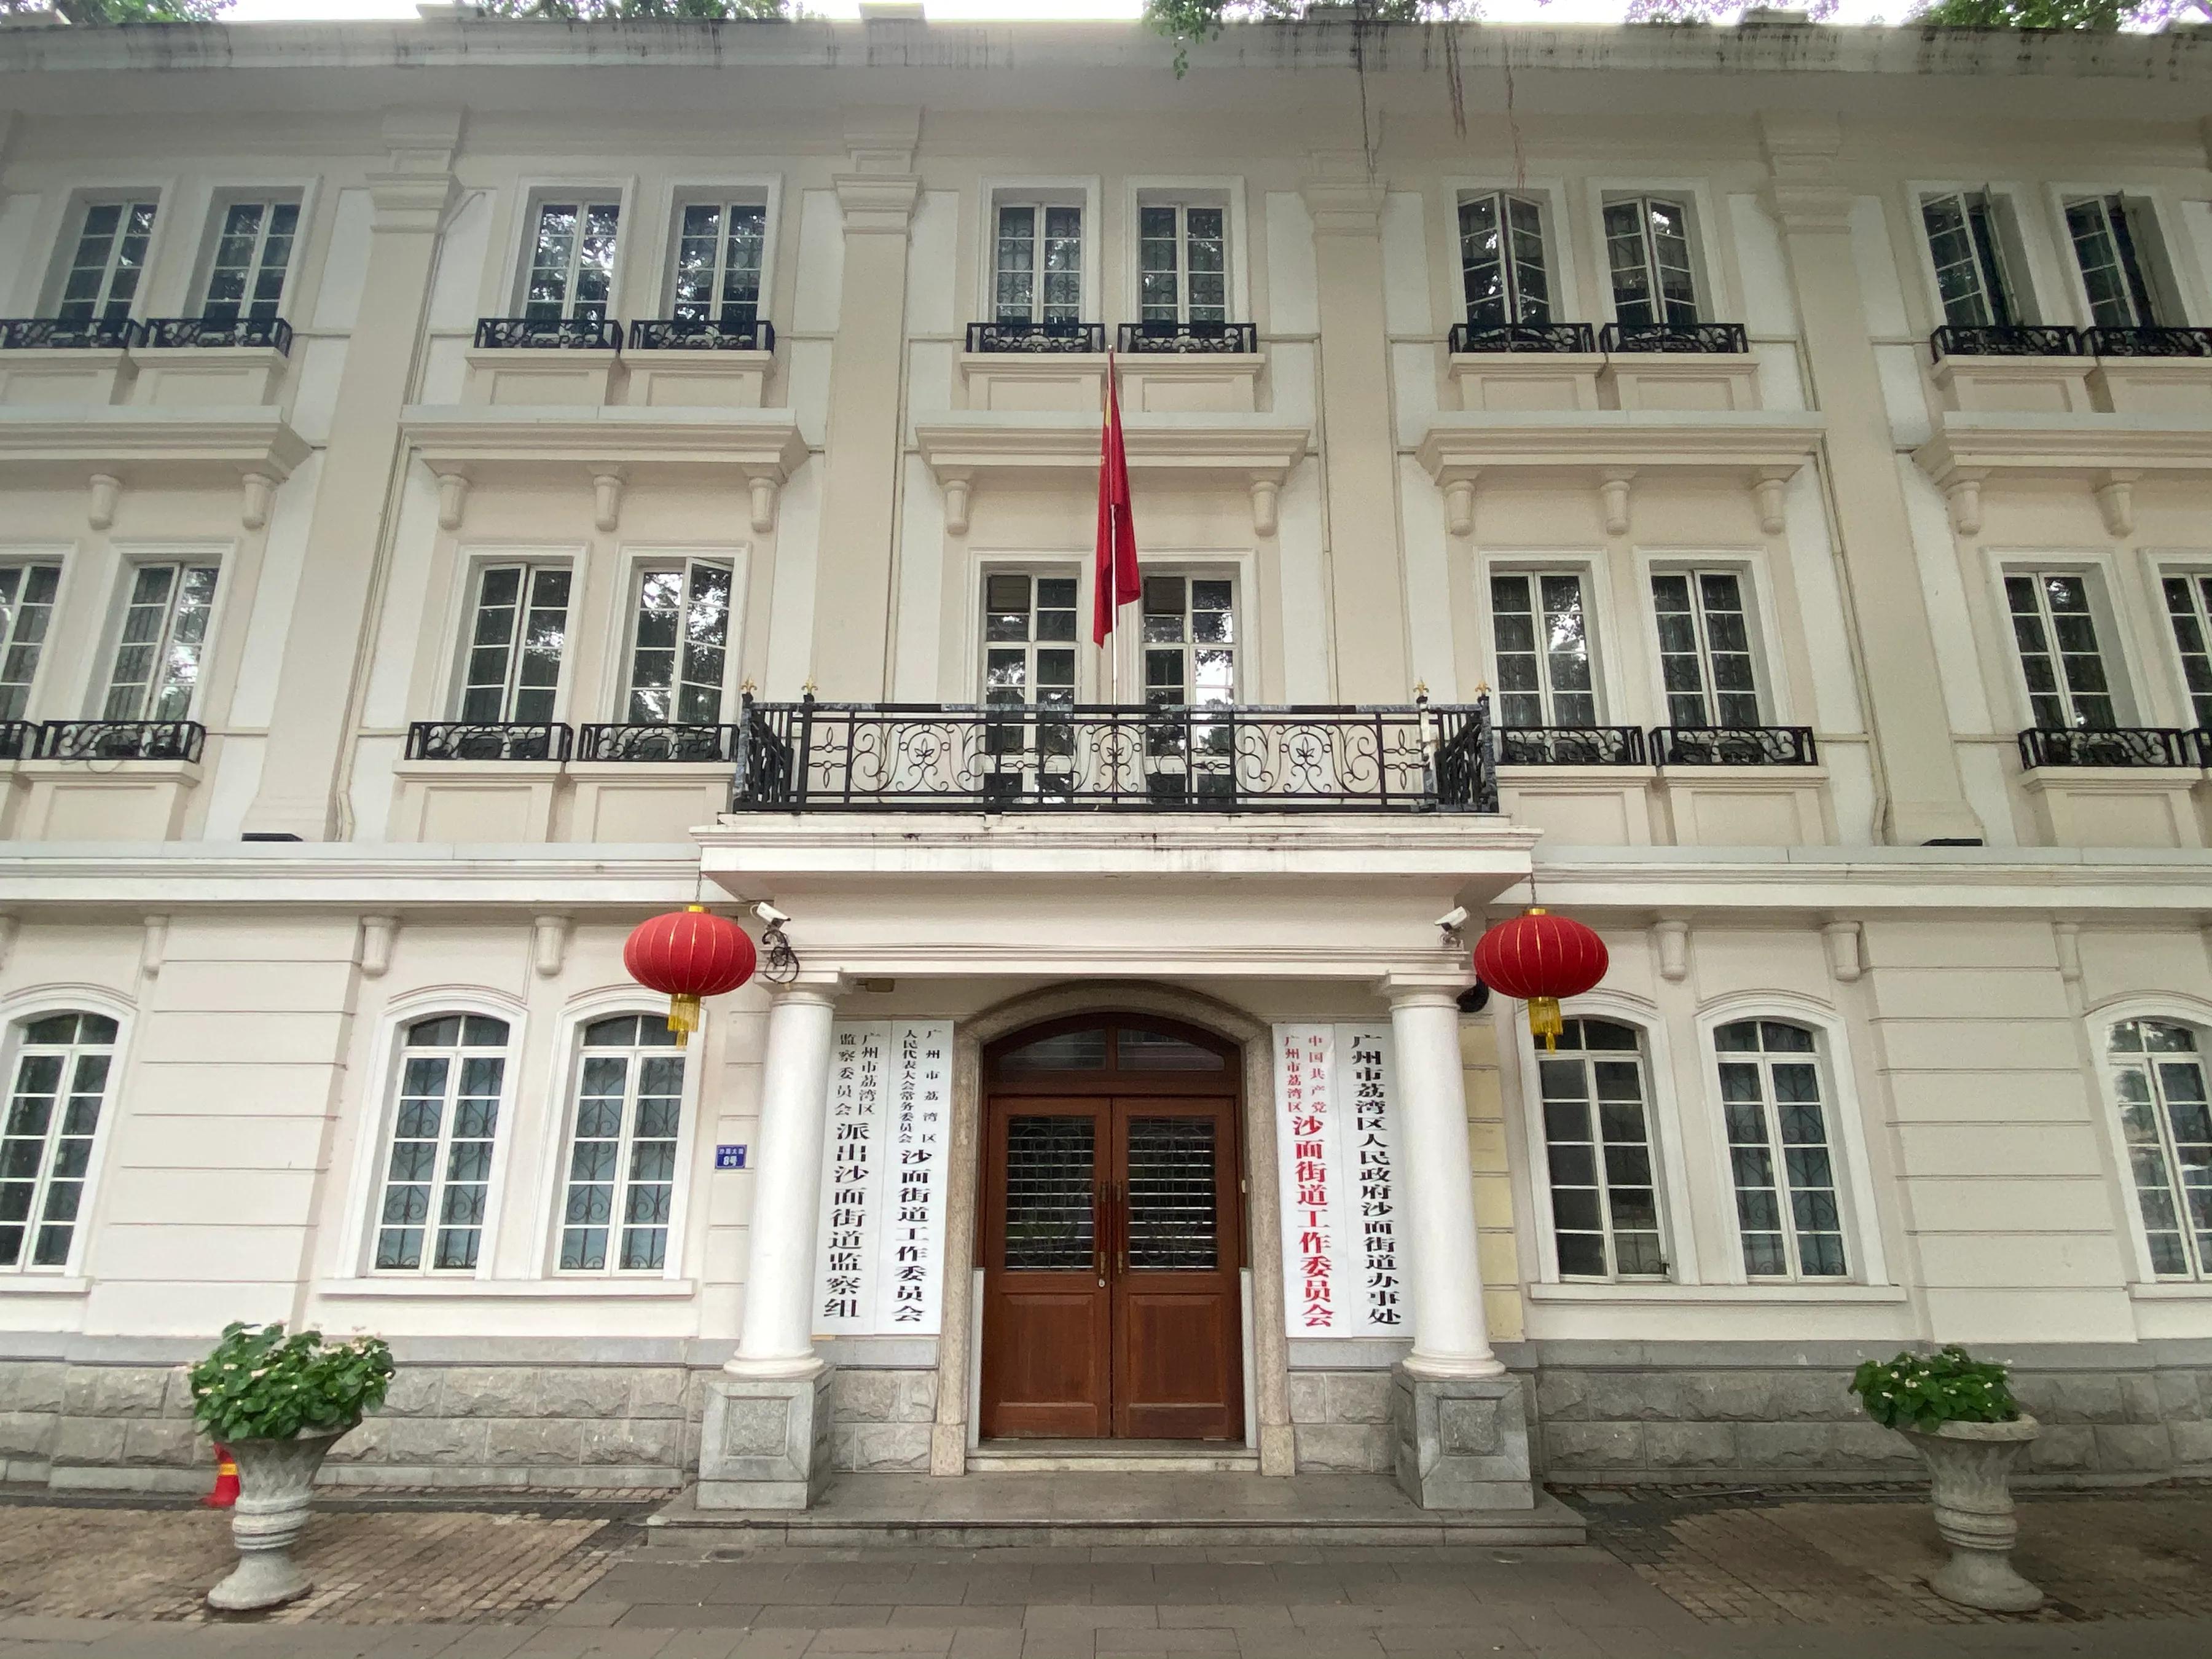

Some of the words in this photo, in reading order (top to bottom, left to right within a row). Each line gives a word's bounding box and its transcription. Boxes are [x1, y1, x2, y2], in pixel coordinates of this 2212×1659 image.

[834, 1032, 856, 1115] 监察委员会
[858, 1032, 881, 1115] 广州市荔湾区
[898, 1029, 917, 1143] 人民代表大会常务委员会
[923, 1029, 941, 1143] 广州市荔湾区
[1284, 1035, 1302, 1113] 广州市荔湾区
[1308, 1035, 1327, 1113] 中国共产党
[823, 1122, 870, 1319] 派出沙面街道监察组
[892, 1149, 932, 1322] 沙面街道工作委员会
[1292, 1115, 1335, 1328] 沙面街道工作委员会
[1352, 1034, 1402, 1325] 广州市荔湾区人民政府沙面街道办事处
